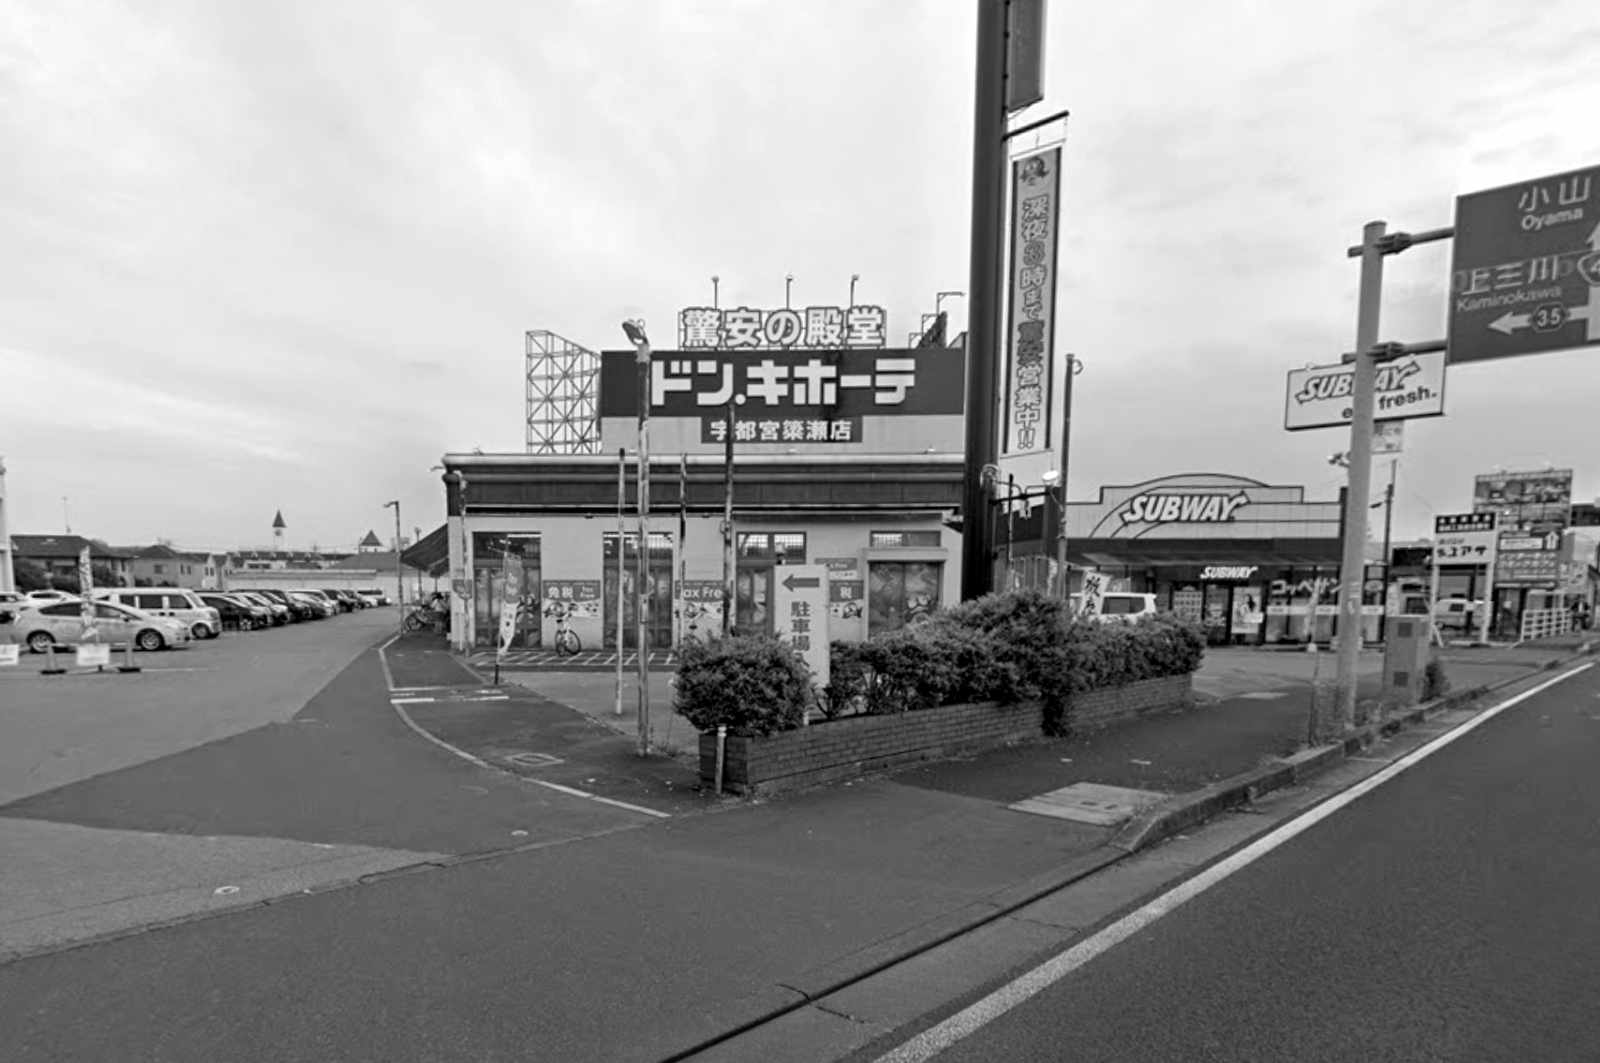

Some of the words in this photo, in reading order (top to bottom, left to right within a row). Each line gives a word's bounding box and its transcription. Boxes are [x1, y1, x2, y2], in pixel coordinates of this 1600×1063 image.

[1518, 176, 1591, 212] 小山
[1522, 208, 1583, 230] Oyama
[1461, 255, 1559, 295] 上三川
[1457, 286, 1562, 313] Kaminokawa
[682, 305, 884, 347] 驚安の殿堂
[1536, 307, 1561, 328] 35
[1295, 361, 1421, 405] SUBAY
[1379, 386, 1437, 410] fresh.
[1120, 490, 1250, 524] SUBWAY
[1200, 566, 1258, 580] SUBWAY
